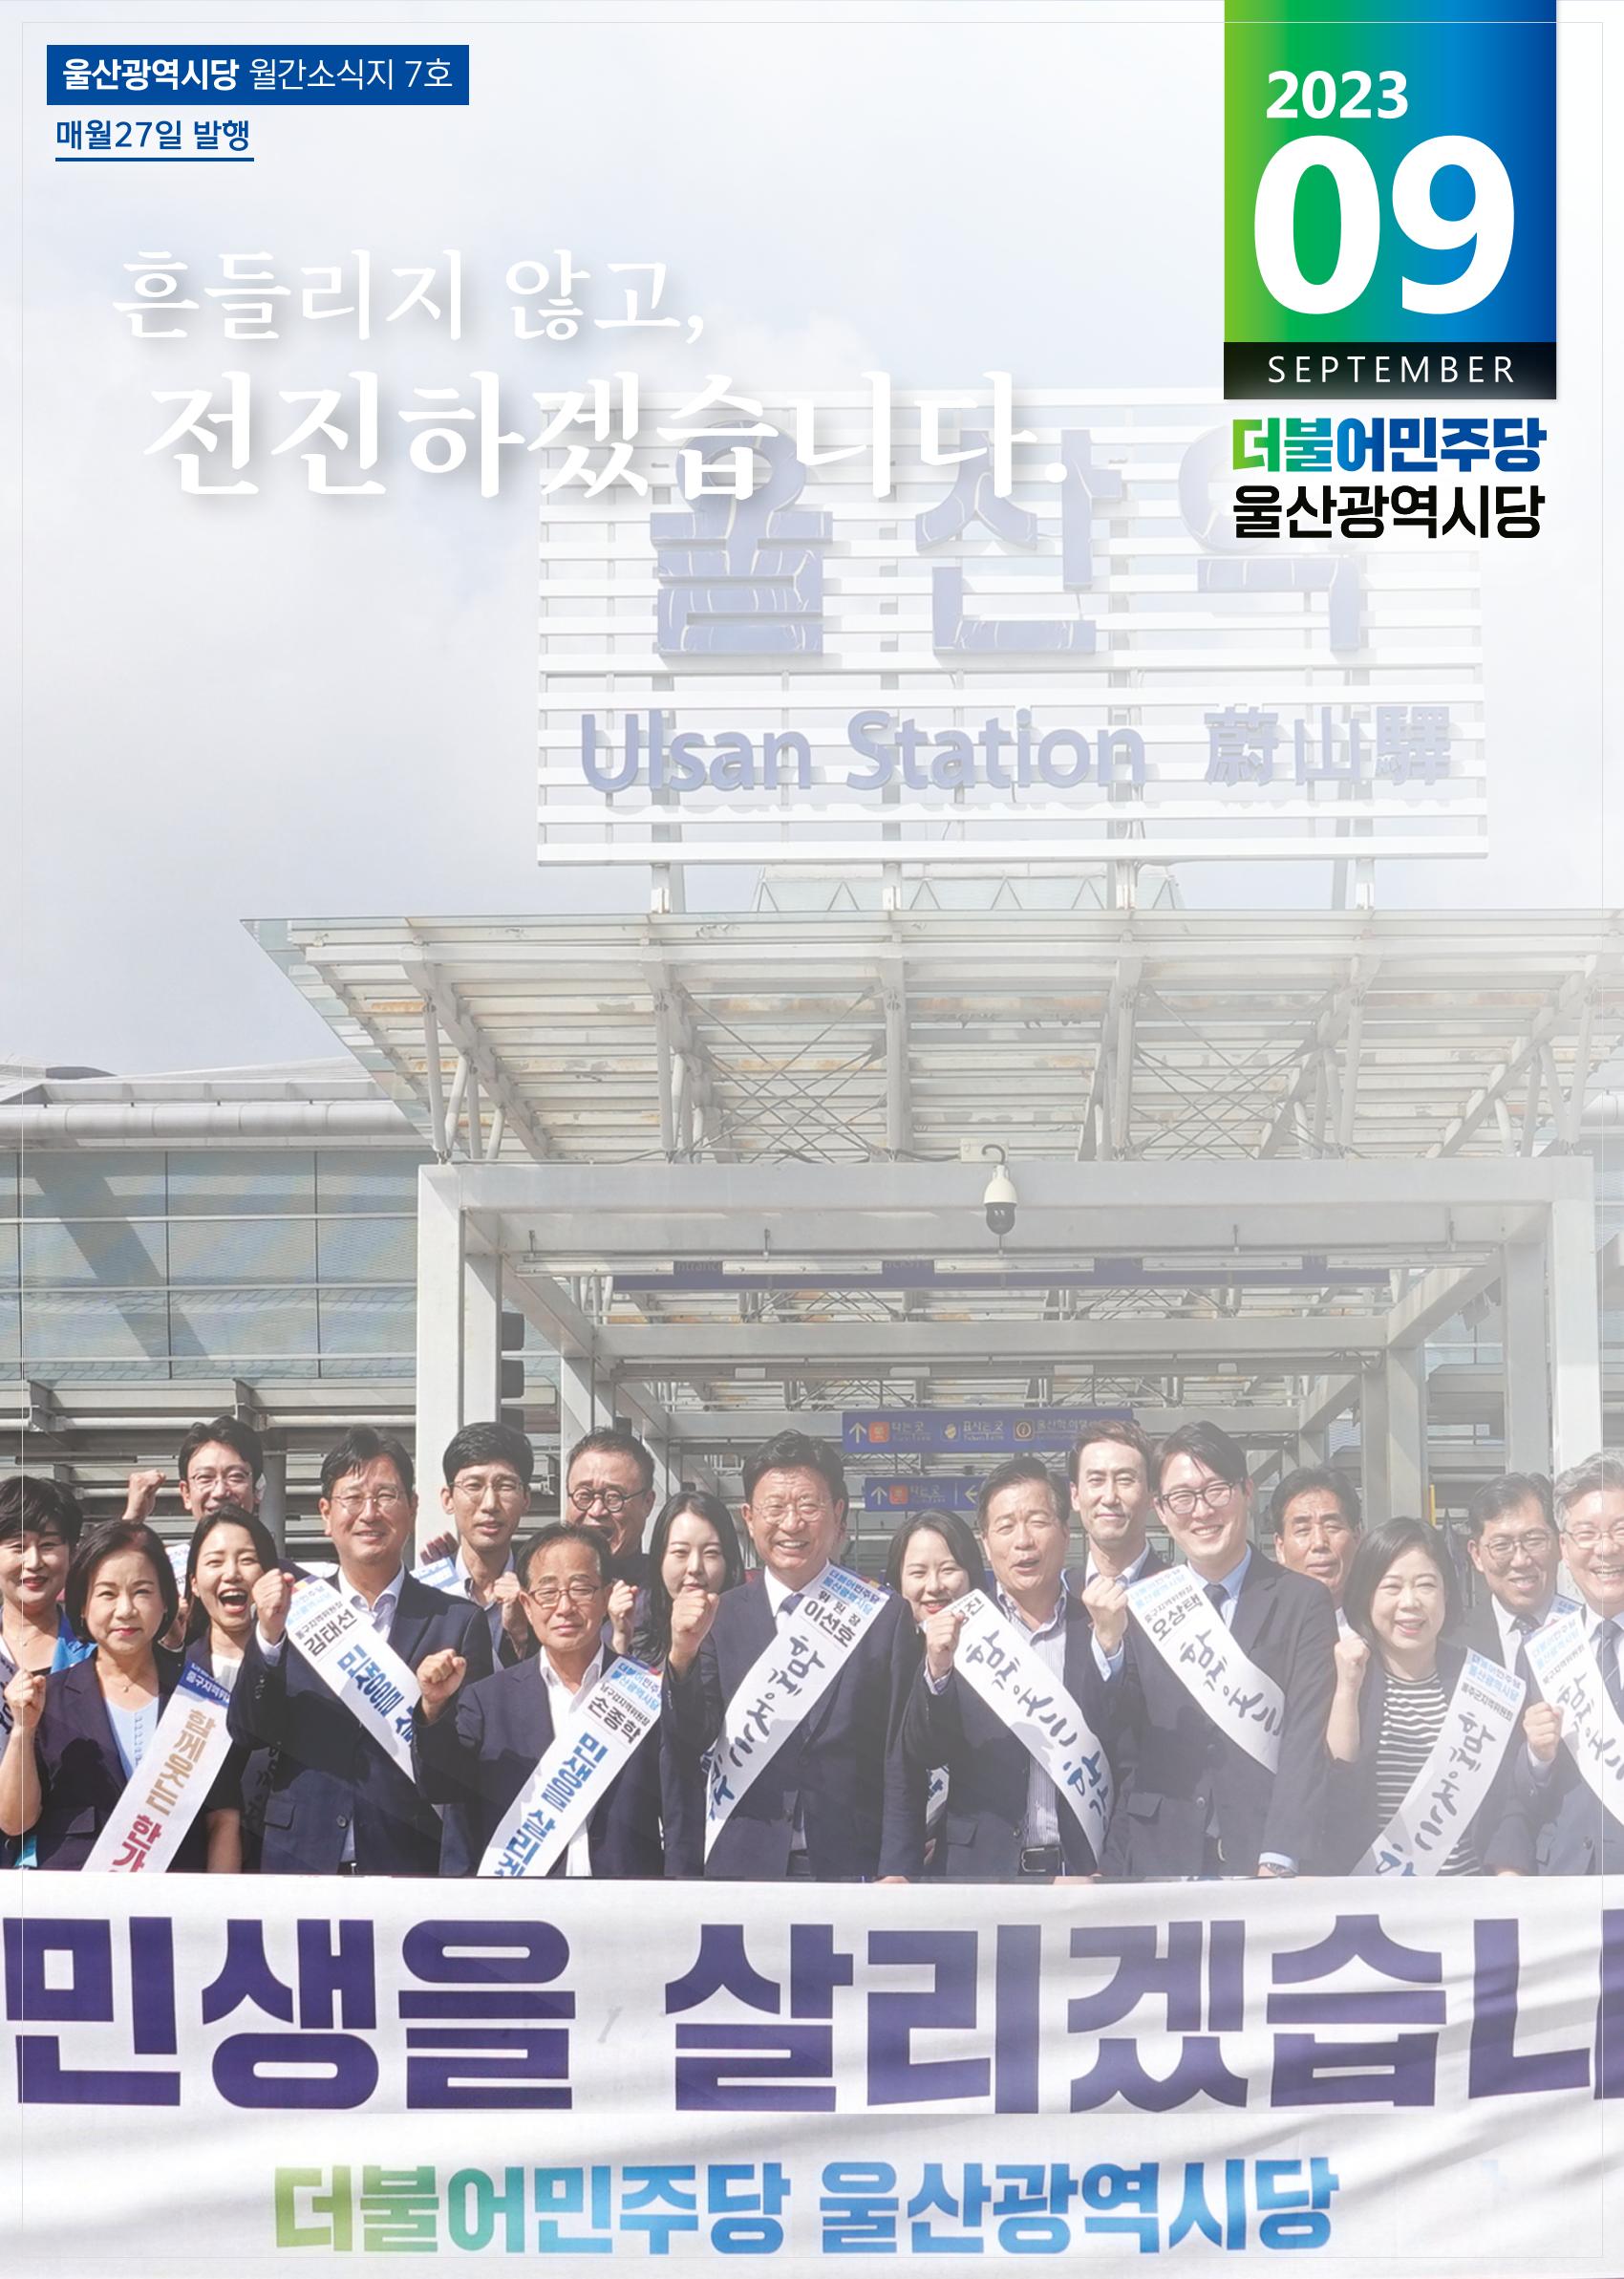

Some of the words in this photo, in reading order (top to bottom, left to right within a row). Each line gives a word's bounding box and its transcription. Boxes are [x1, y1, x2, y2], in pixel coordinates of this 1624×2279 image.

[579, 709, 812, 792] Ulsan
[846, 707, 1147, 792] Station
[304, 1608, 358, 1657] 김태선
[804, 1600, 856, 1648] 이선호
[336, 1643, 405, 1718] 민생을
[588, 1696, 642, 1745] 손종학
[540, 1731, 609, 1814] 민생을
[113, 1814, 162, 1873] 한가
[2, 1916, 577, 2110] 민생을
[274, 2162, 792, 2256] 더불어민주당
[821, 2157, 1340, 2255] 울산광역시당
